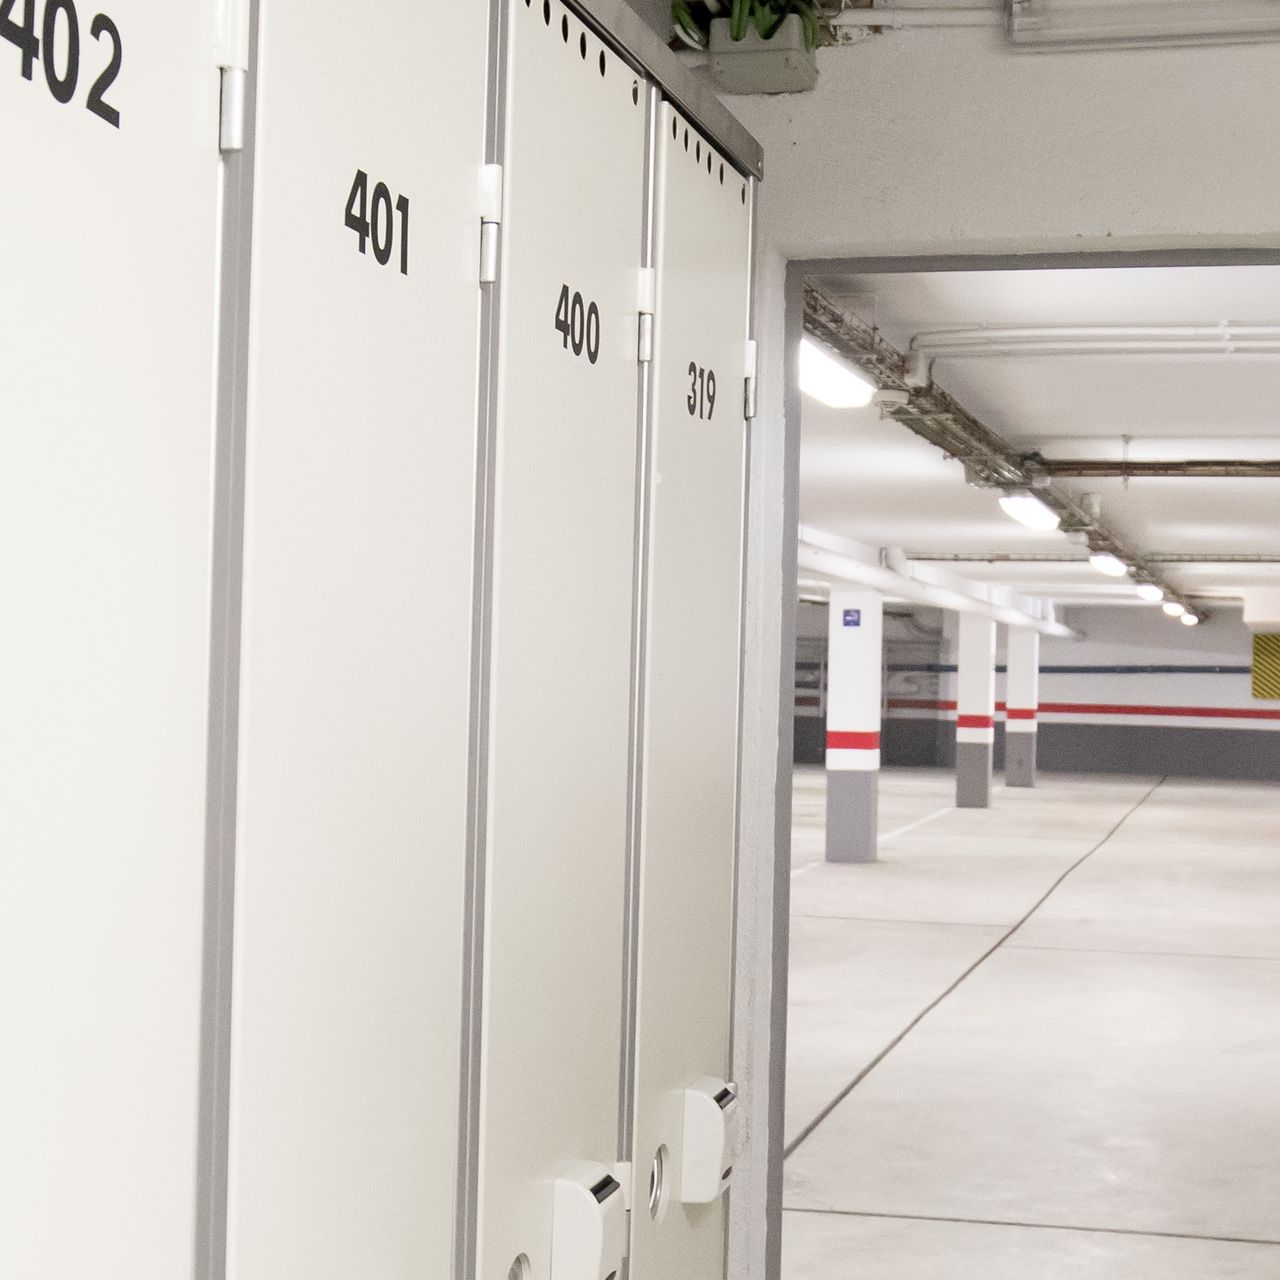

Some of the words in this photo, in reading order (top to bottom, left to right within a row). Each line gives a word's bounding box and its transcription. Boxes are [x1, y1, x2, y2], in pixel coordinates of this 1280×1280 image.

[344, 168, 410, 276] 401
[554, 283, 600, 365] 400
[687, 361, 716, 421] 319
